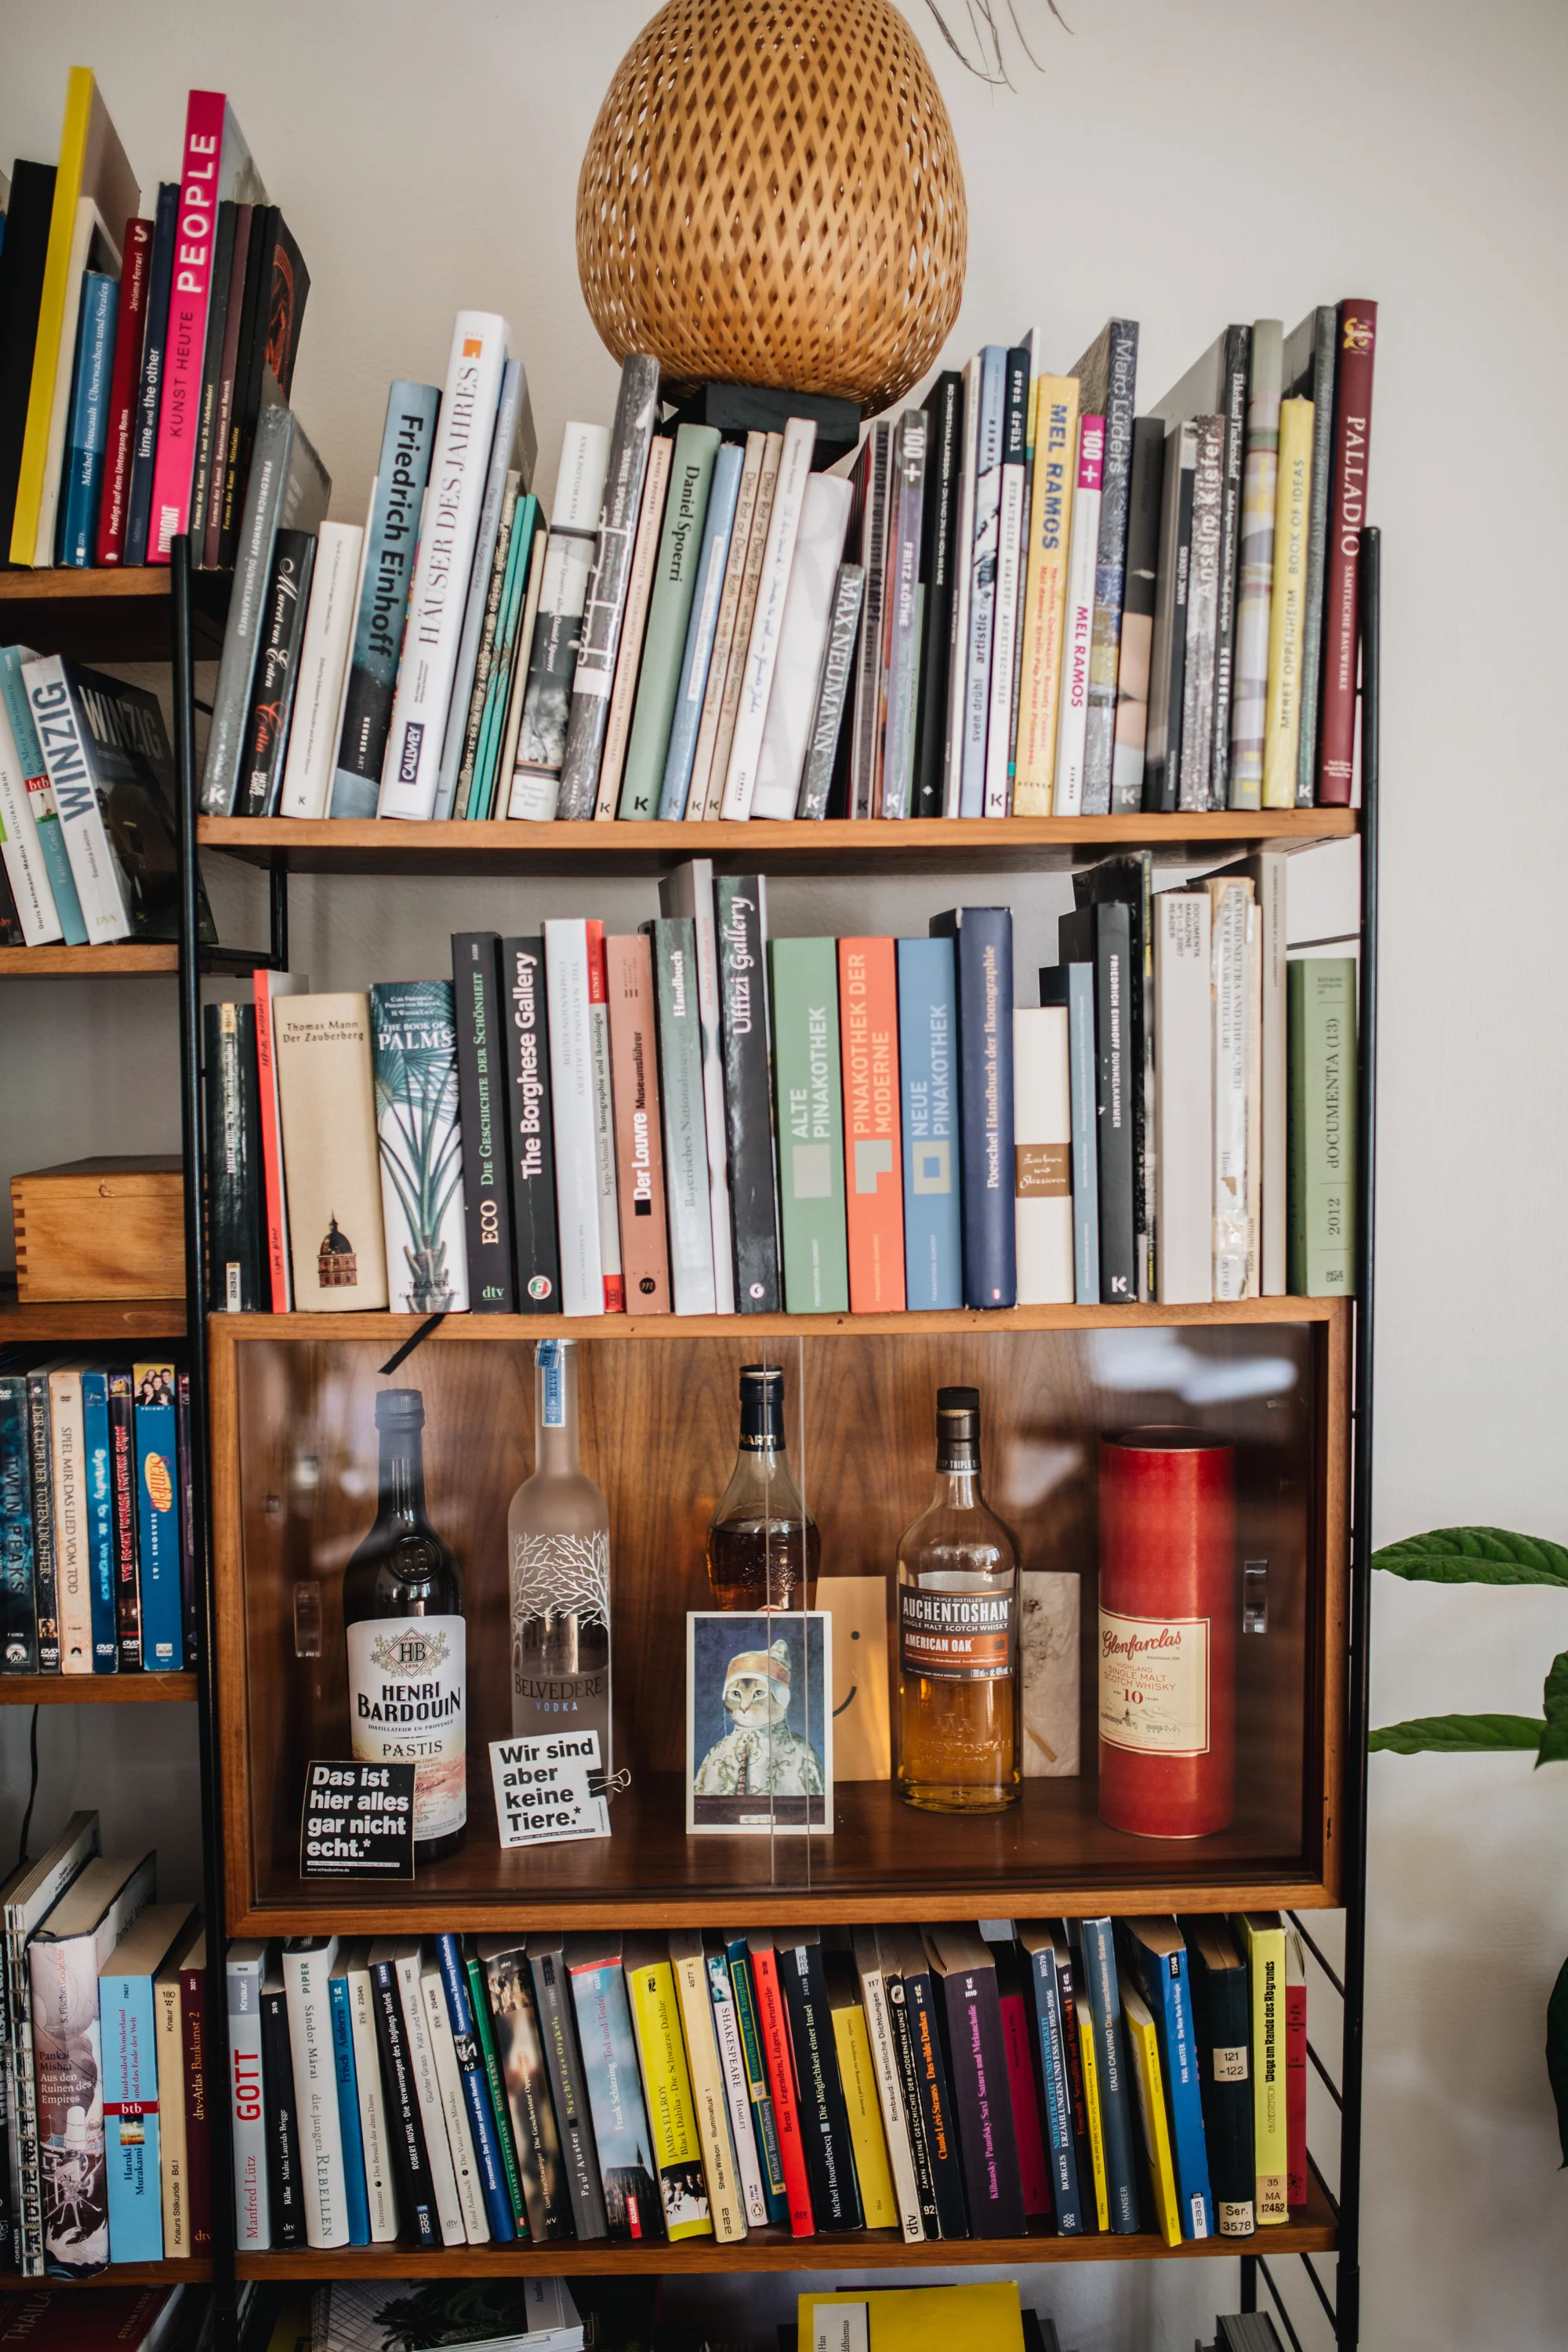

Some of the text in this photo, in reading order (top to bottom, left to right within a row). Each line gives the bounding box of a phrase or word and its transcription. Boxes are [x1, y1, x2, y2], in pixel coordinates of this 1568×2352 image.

[176, 133, 216, 292] PEOPLE
[81, 282, 110, 486] Michel Foucault Überwachen und Strafen
[169, 310, 193, 437] KUNST HEUTE
[137, 347, 159, 457] time and the other
[1107, 339, 1134, 475] Marc Lüders
[1046, 403, 1069, 453] MEL
[413, 365, 480, 645] HÄUSER DES JAHRES
[1038, 461, 1065, 550] RAMOS
[1337, 416, 1369, 557] PALLADIO
[157, 505, 180, 554] DUMONT
[365, 415, 426, 658] Friedrich Einhoff
[664, 464, 701, 583] Daniel Spoerri
[1193, 433, 1221, 598] Anselm Kiefer
[1074, 605, 1088, 641] MEL
[812, 575, 859, 754] MAX NEUMANN
[1069, 645, 1087, 707] RAMOS
[29, 680, 96, 823] WINZIG
[401, 725, 423, 780] CALLWEY
[670, 949, 685, 1017] Handbuch
[723, 895, 756, 1034] Uffizi Gallery
[283, 1032, 364, 1043] Der Zauberberg
[287, 1021, 358, 1033] Thomas Mann
[378, 1029, 455, 1051] PALMS
[848, 953, 869, 1134] PINAKOTHEK DER
[511, 951, 544, 1179] The Borghese Gallery
[808, 1006, 830, 1138] PINAKOTHEK
[872, 1031, 891, 1132] MODERNE
[929, 1003, 949, 1135] PINAKOTHEK
[982, 945, 999, 1187] Poeschel Handbuch der Ikonographie
[630, 1031, 651, 1200] Der Louvre Museumsführer
[790, 1088, 808, 1138] ALTE
[909, 1080, 930, 1136] NEUE
[1324, 1017, 1341, 1168] dOCUMENTA (13)
[480, 1199, 499, 1244] ECO
[1327, 1197, 1341, 1235] 2012
[149, 1454, 172, 1512] Seinfeld
[3, 1457, 25, 1592] TWIN PEAKS
[60, 1427, 78, 1594] SPIEL MIR DAS LIED VOM TOD
[902, 1618, 922, 1628] SINGLE
[980, 1622, 1008, 1631] WHISKY
[903, 1596, 1008, 1623] AUCHENTOSHAN
[905, 1633, 972, 1653] AMERICAN OAK
[1102, 1628, 1181, 1661] Glenfarclas
[1116, 1662, 1153, 1673] HIGHLAND
[382, 1681, 441, 1701] HENRI
[514, 1673, 602, 1700] BELVEDERE
[1103, 1671, 1176, 1691] SCOTCH WHISKY
[1108, 1665, 1167, 1682] SINGLE MALT
[1123, 1689, 1143, 1704] 10
[358, 1686, 461, 1722] BARDOUIN
[536, 1701, 579, 1711] VODKA
[383, 1740, 443, 1757] PASTIS
[499, 1737, 593, 1764] Wir sind
[310, 1790, 409, 1812] hier alles
[313, 1766, 390, 1787] Das ist
[503, 1766, 558, 1788] aber
[505, 1788, 574, 1809] keine
[307, 1817, 345, 1837] gar
[350, 1815, 406, 1835] nicht
[300, 1962, 310, 1994] PIPER
[1097, 1933, 1118, 2091] ITALO CALVINO Die unsichtbaren Städte
[40, 2051, 70, 2061] Pankaj
[304, 2005, 319, 2079] Sándor Márai
[720, 2006, 742, 2089] SHAKESPEARE
[872, 1991, 899, 2122] Rimbaud: Sämtliche Dichtungen
[1224, 2053, 1239, 2061] 121
[42, 2081, 92, 2092] Ruinen des
[60, 2072, 77, 2082] den
[119, 2055, 129, 2099] Hard-boiled
[235, 2049, 261, 2122] GOTT
[1219, 2066, 1243, 2075] -122
[42, 2095, 80, 2105] Empires
[122, 2103, 142, 2114] btb
[607, 2062, 624, 2130] Frank Schätzing
[803, 2003, 842, 2218] Michel Houellebecq Die Möglichkeit einer Insel
[310, 2093, 323, 2151] die jungen
[123, 2147, 132, 2180] Haruki
[134, 2147, 143, 2194] Murakami
[278, 2108, 291, 2205] Rilke Malte Laurids Brigge
[1058, 2154, 1069, 2190] BORGES
[243, 2154, 258, 2238] Manfred Lütz
[317, 2154, 333, 2237] REBELLEN
[1225, 2205, 1248, 2216] Ser.
[1261, 2203, 1285, 2213] 12452
[1265, 2192, 1281, 2201] MA
[1223, 2221, 1251, 2231] 3578
